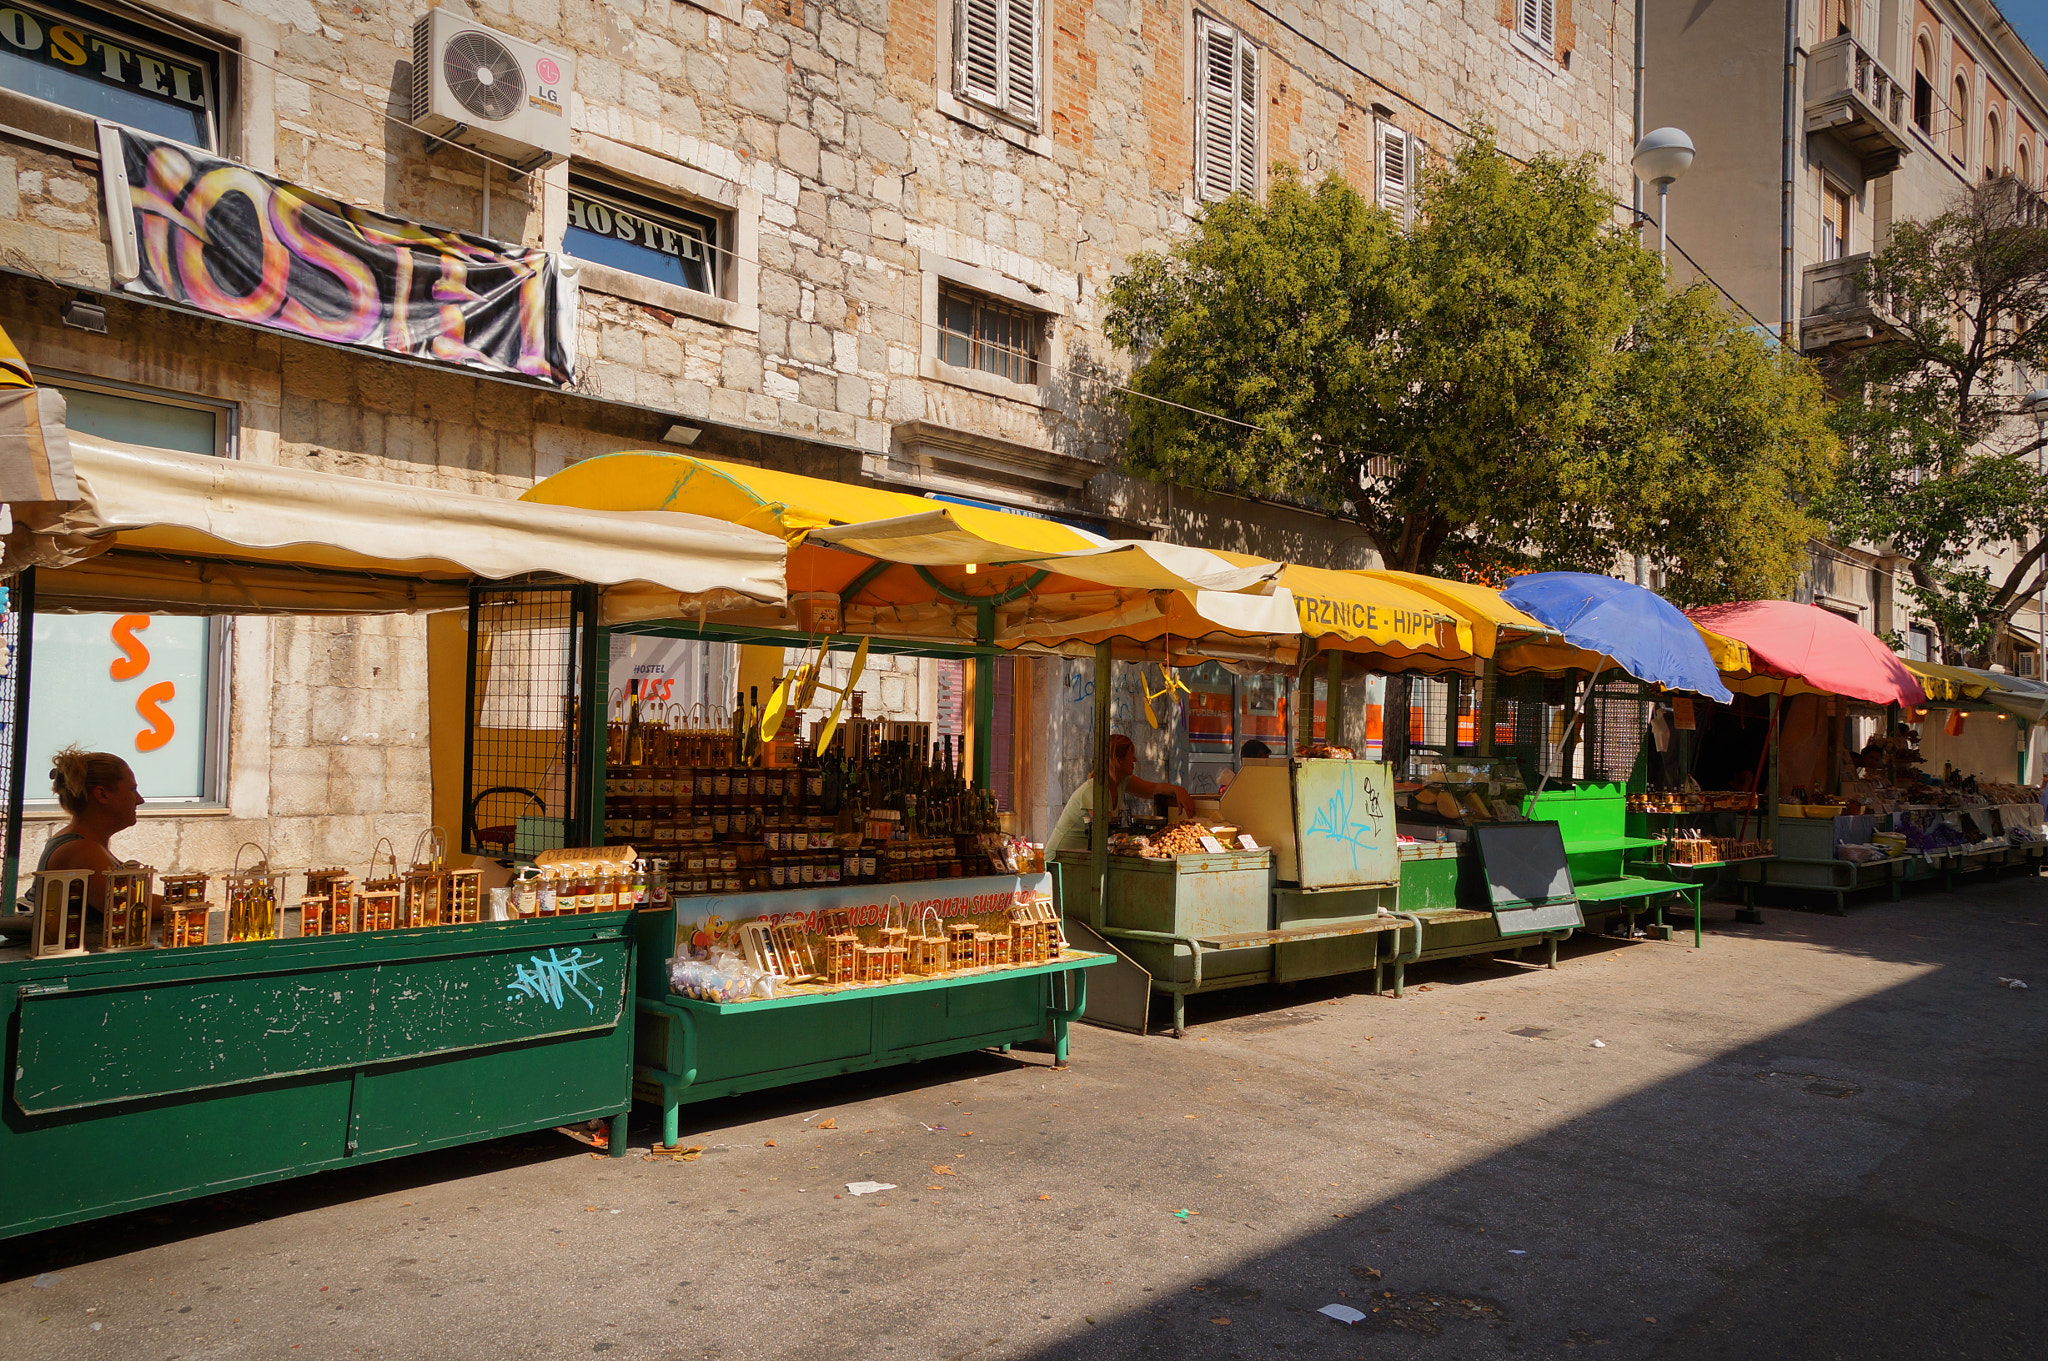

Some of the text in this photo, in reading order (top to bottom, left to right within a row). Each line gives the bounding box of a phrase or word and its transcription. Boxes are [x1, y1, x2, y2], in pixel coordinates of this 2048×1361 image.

[539, 86, 557, 102] LG
[567, 198, 700, 262] HOSTEL
[633, 664, 666, 674] HOSTEL
[547, 846, 628, 860] DEGUSTACIJA
